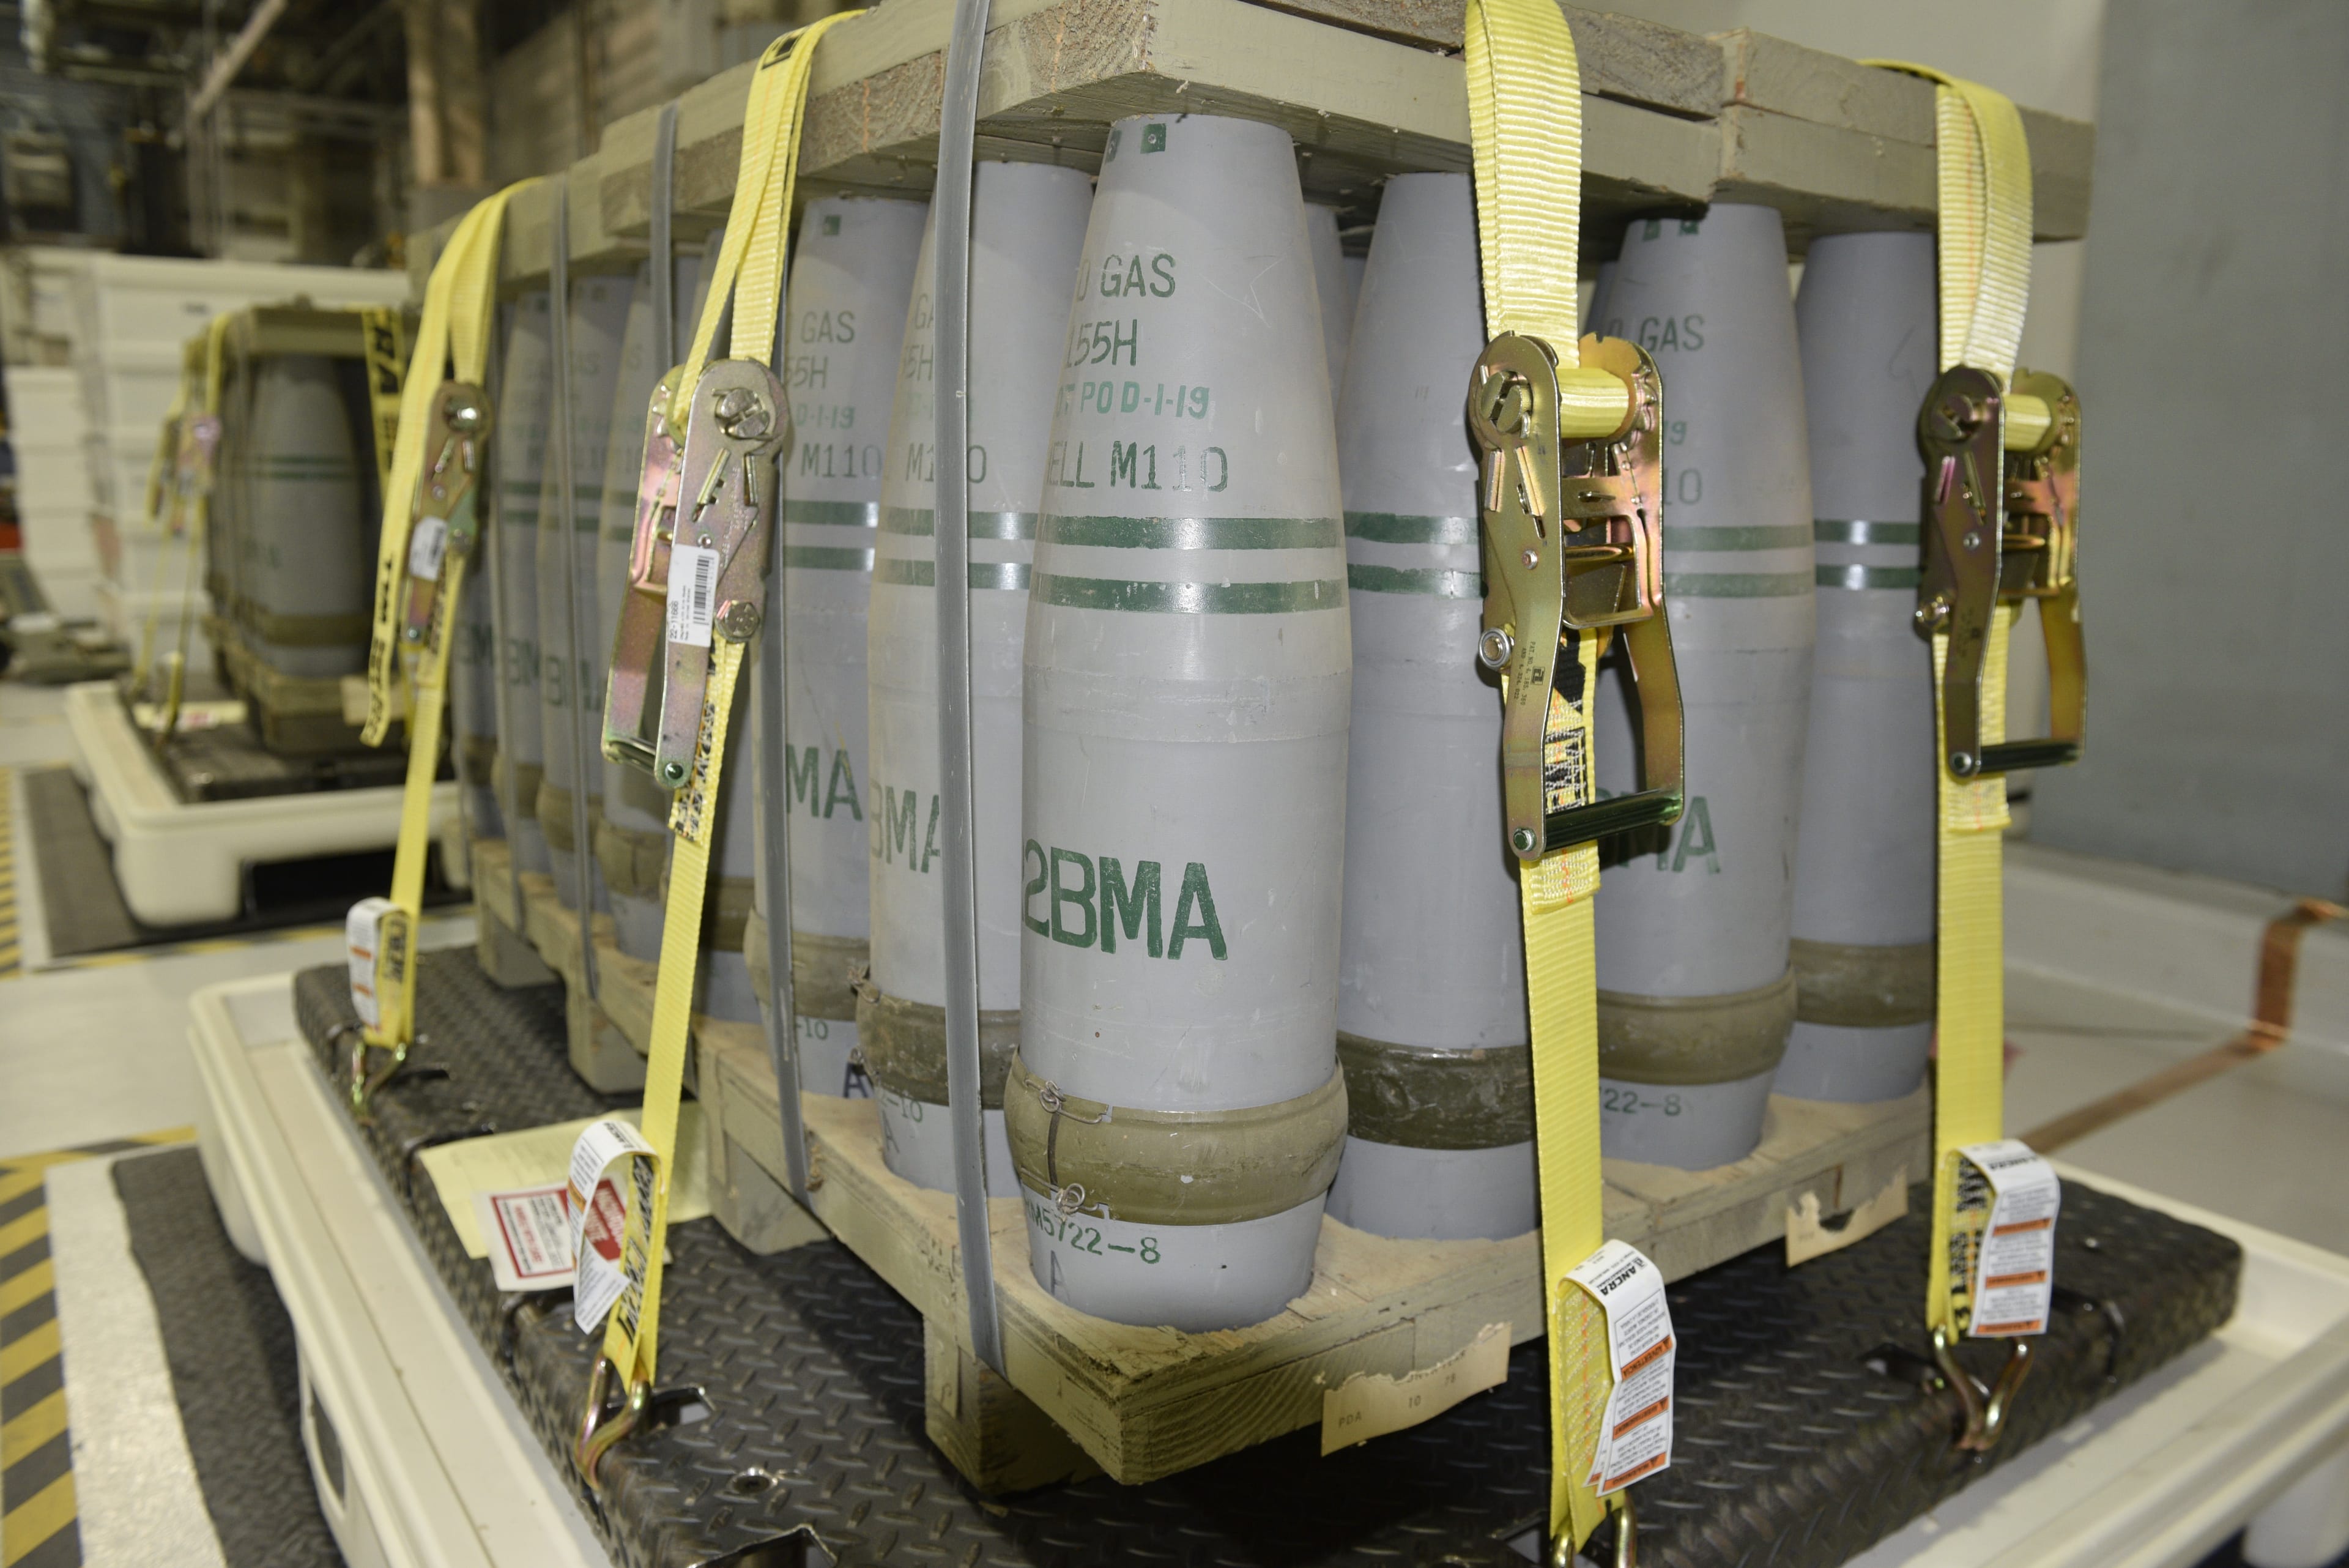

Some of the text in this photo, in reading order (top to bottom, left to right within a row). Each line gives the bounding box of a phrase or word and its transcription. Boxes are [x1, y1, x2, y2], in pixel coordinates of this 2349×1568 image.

[1100, 253, 1176, 298] GAS
[800, 310, 855, 344] GAS
[1638, 314, 1705, 352] GAS
[800, 442, 883, 478] M110
[1110, 440, 1228, 492] M110
[1025, 1199, 1161, 1265] M5722-8
[1600, 1265, 1637, 1296] ANCRA
[1338, 1411, 1363, 1429] PDA
[1408, 1395, 1422, 1409] 10
